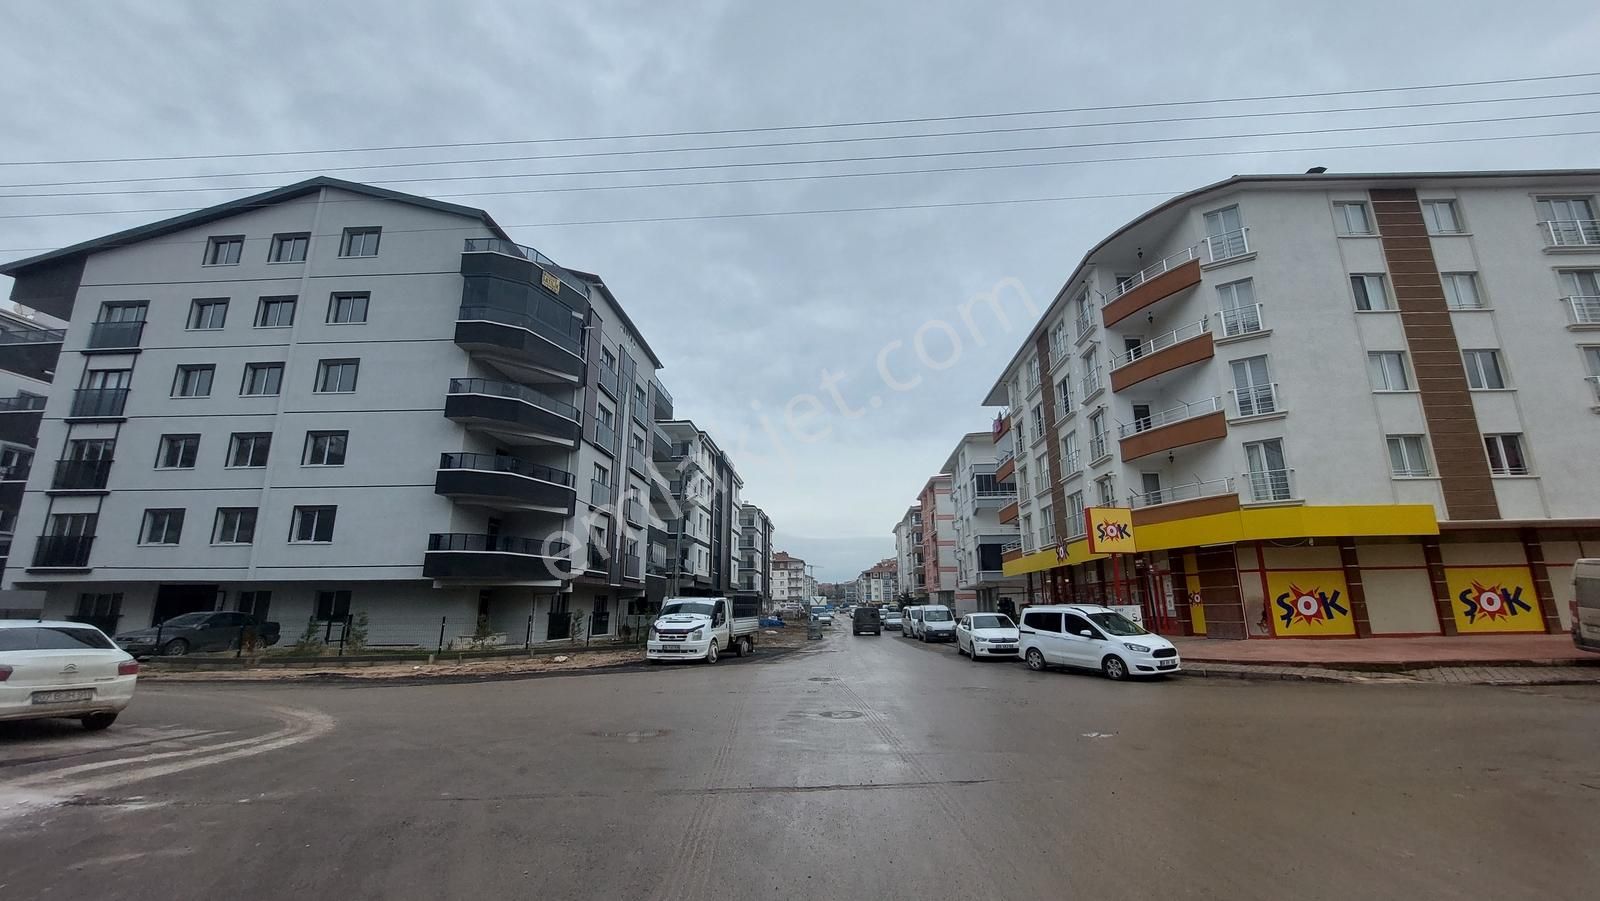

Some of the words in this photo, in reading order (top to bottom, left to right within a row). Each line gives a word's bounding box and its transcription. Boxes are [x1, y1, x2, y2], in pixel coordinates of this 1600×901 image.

[1096, 522, 1131, 543] ŞOK
[1276, 589, 1348, 629] ŞOK
[1458, 585, 1533, 625] ŞOK
